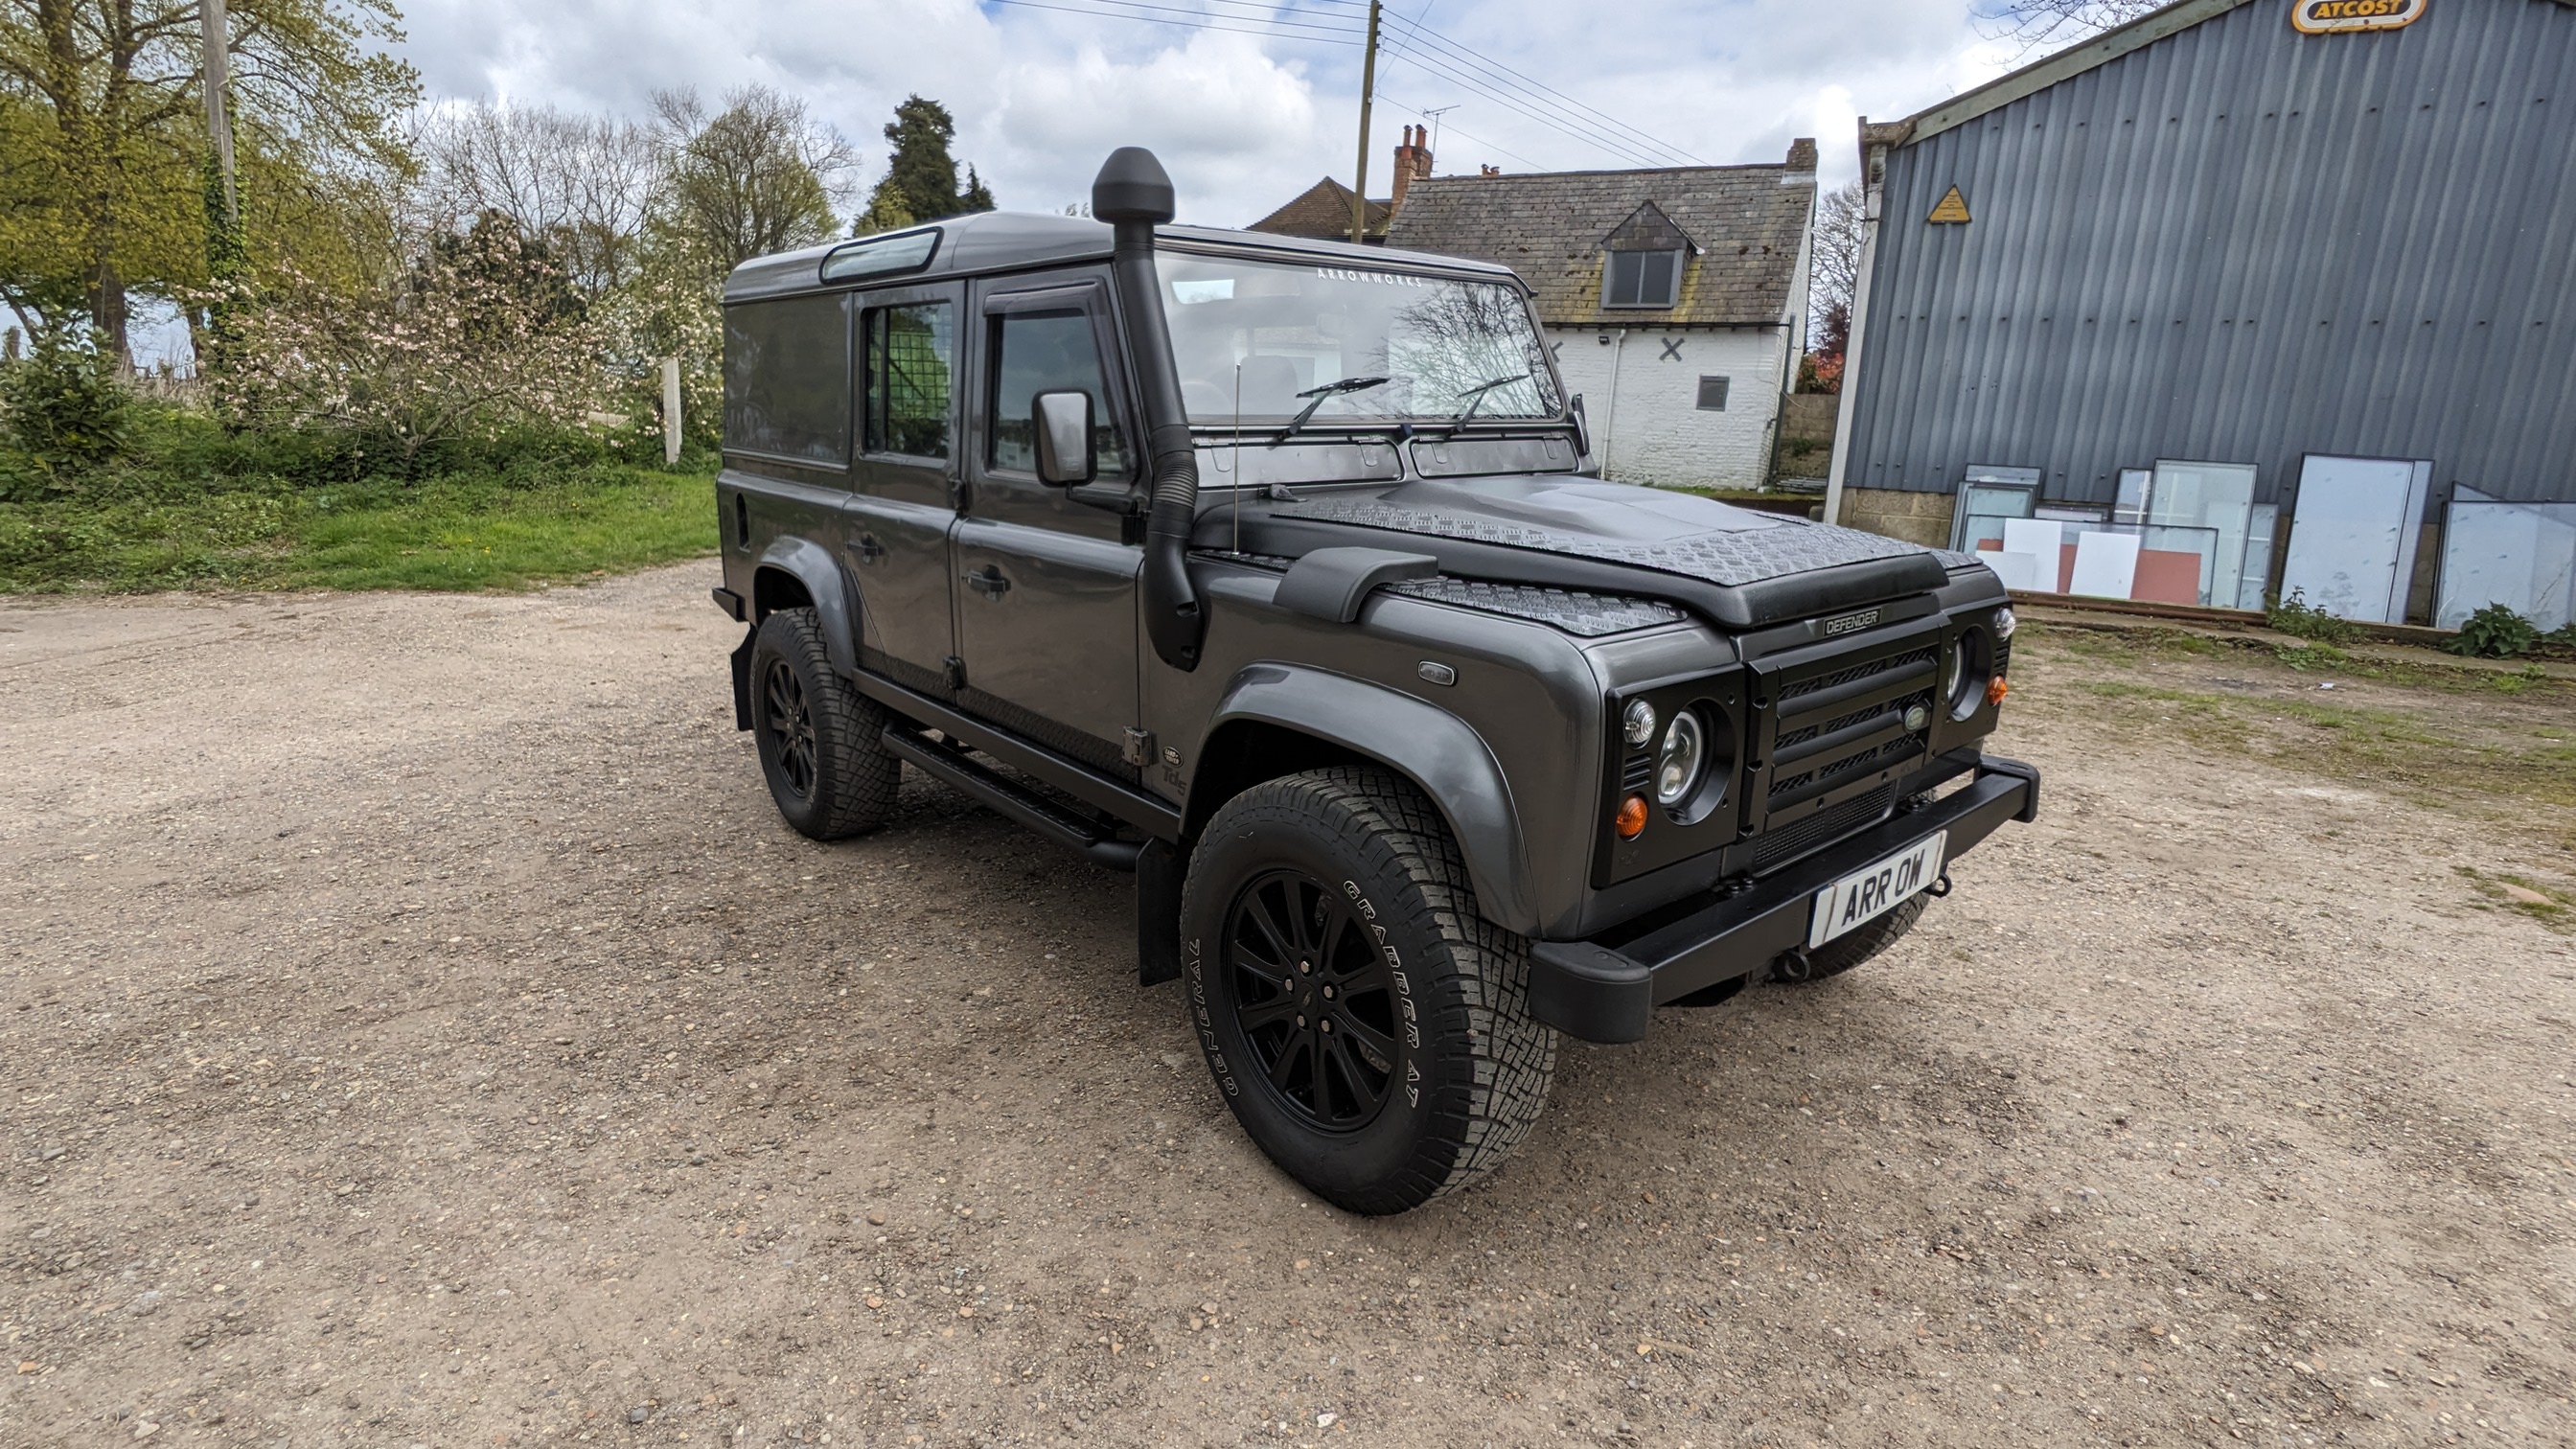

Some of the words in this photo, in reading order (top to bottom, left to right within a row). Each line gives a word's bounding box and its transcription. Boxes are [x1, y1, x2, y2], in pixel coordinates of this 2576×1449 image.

[2313, 0, 2403, 18] ATCOST
[1317, 268, 1422, 288] ARROWWORKS
[1826, 610, 1878, 634] DEFENDER
[1162, 764, 1187, 796] Td5
[1841, 867, 1892, 928] ARR
[1895, 848, 1925, 898] OW
[1343, 880, 1419, 1049] GRABBER
[1405, 1058, 1420, 1109] AT
[1187, 937, 1239, 1097] GENERAL
